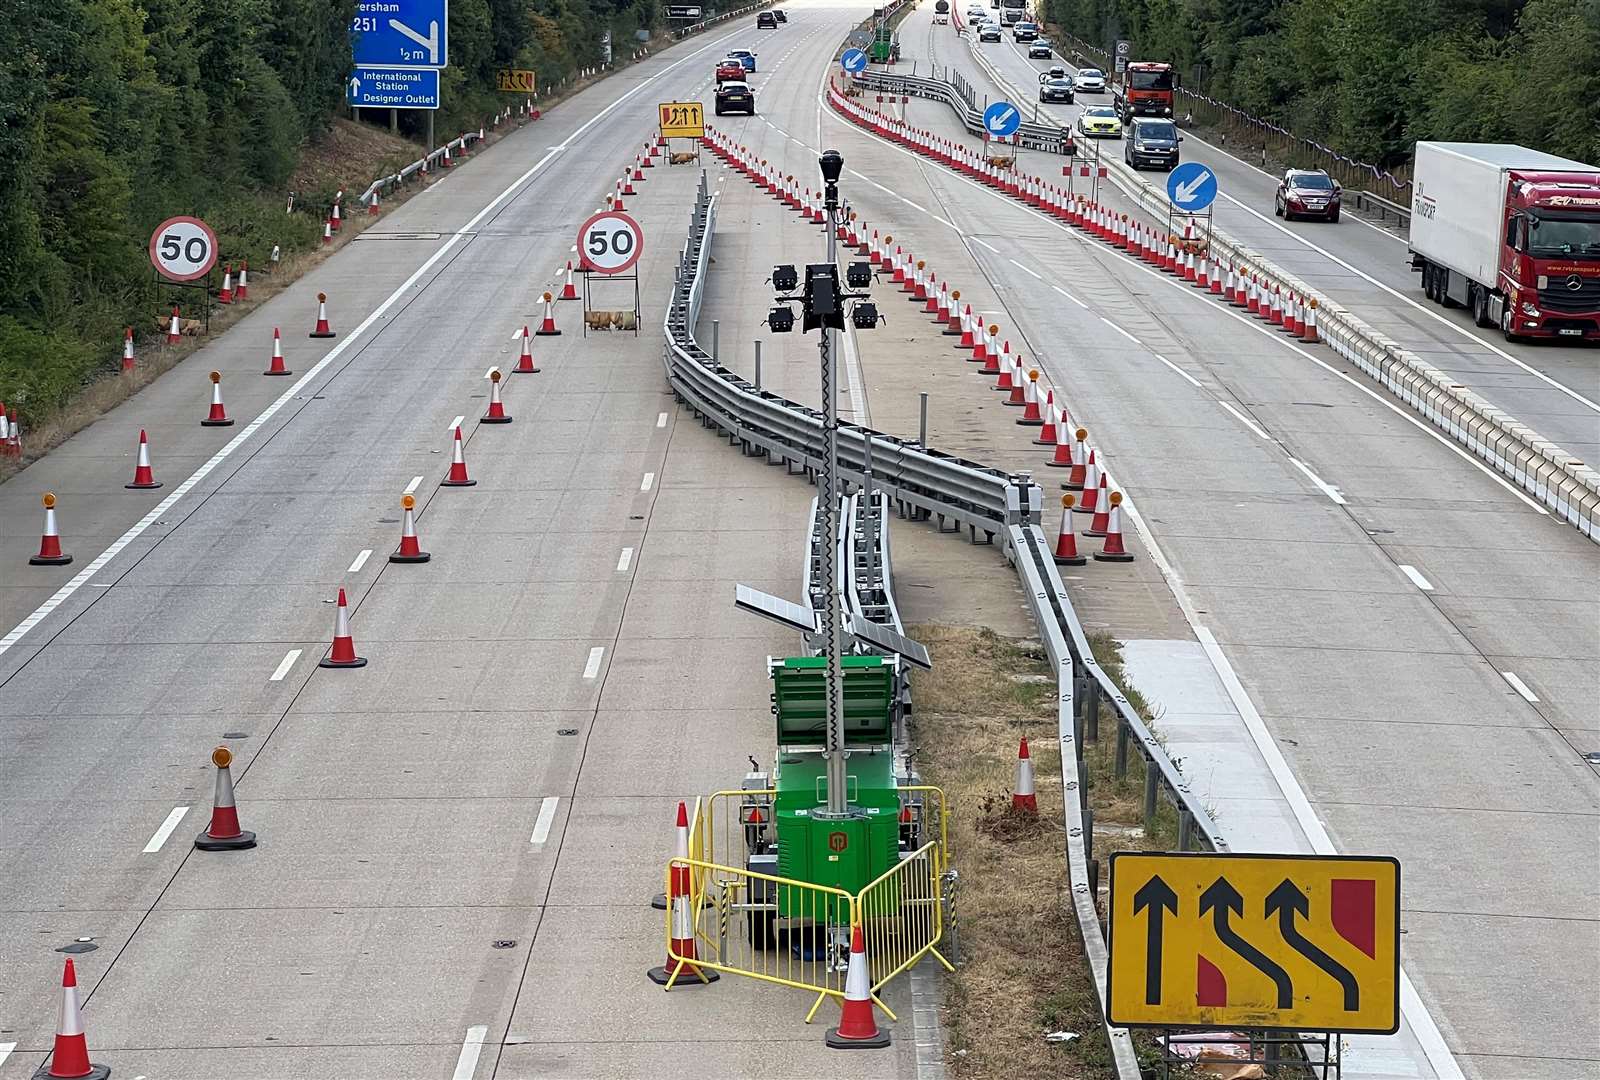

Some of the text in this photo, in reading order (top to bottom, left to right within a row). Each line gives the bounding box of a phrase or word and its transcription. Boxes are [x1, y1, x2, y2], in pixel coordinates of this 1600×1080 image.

[412, 50, 424, 59] m
[363, 72, 421, 81] International
[376, 82, 409, 91] Station
[363, 94, 434, 104] Designer Outlet
[589, 230, 633, 256] 50
[161, 234, 207, 263] 50
